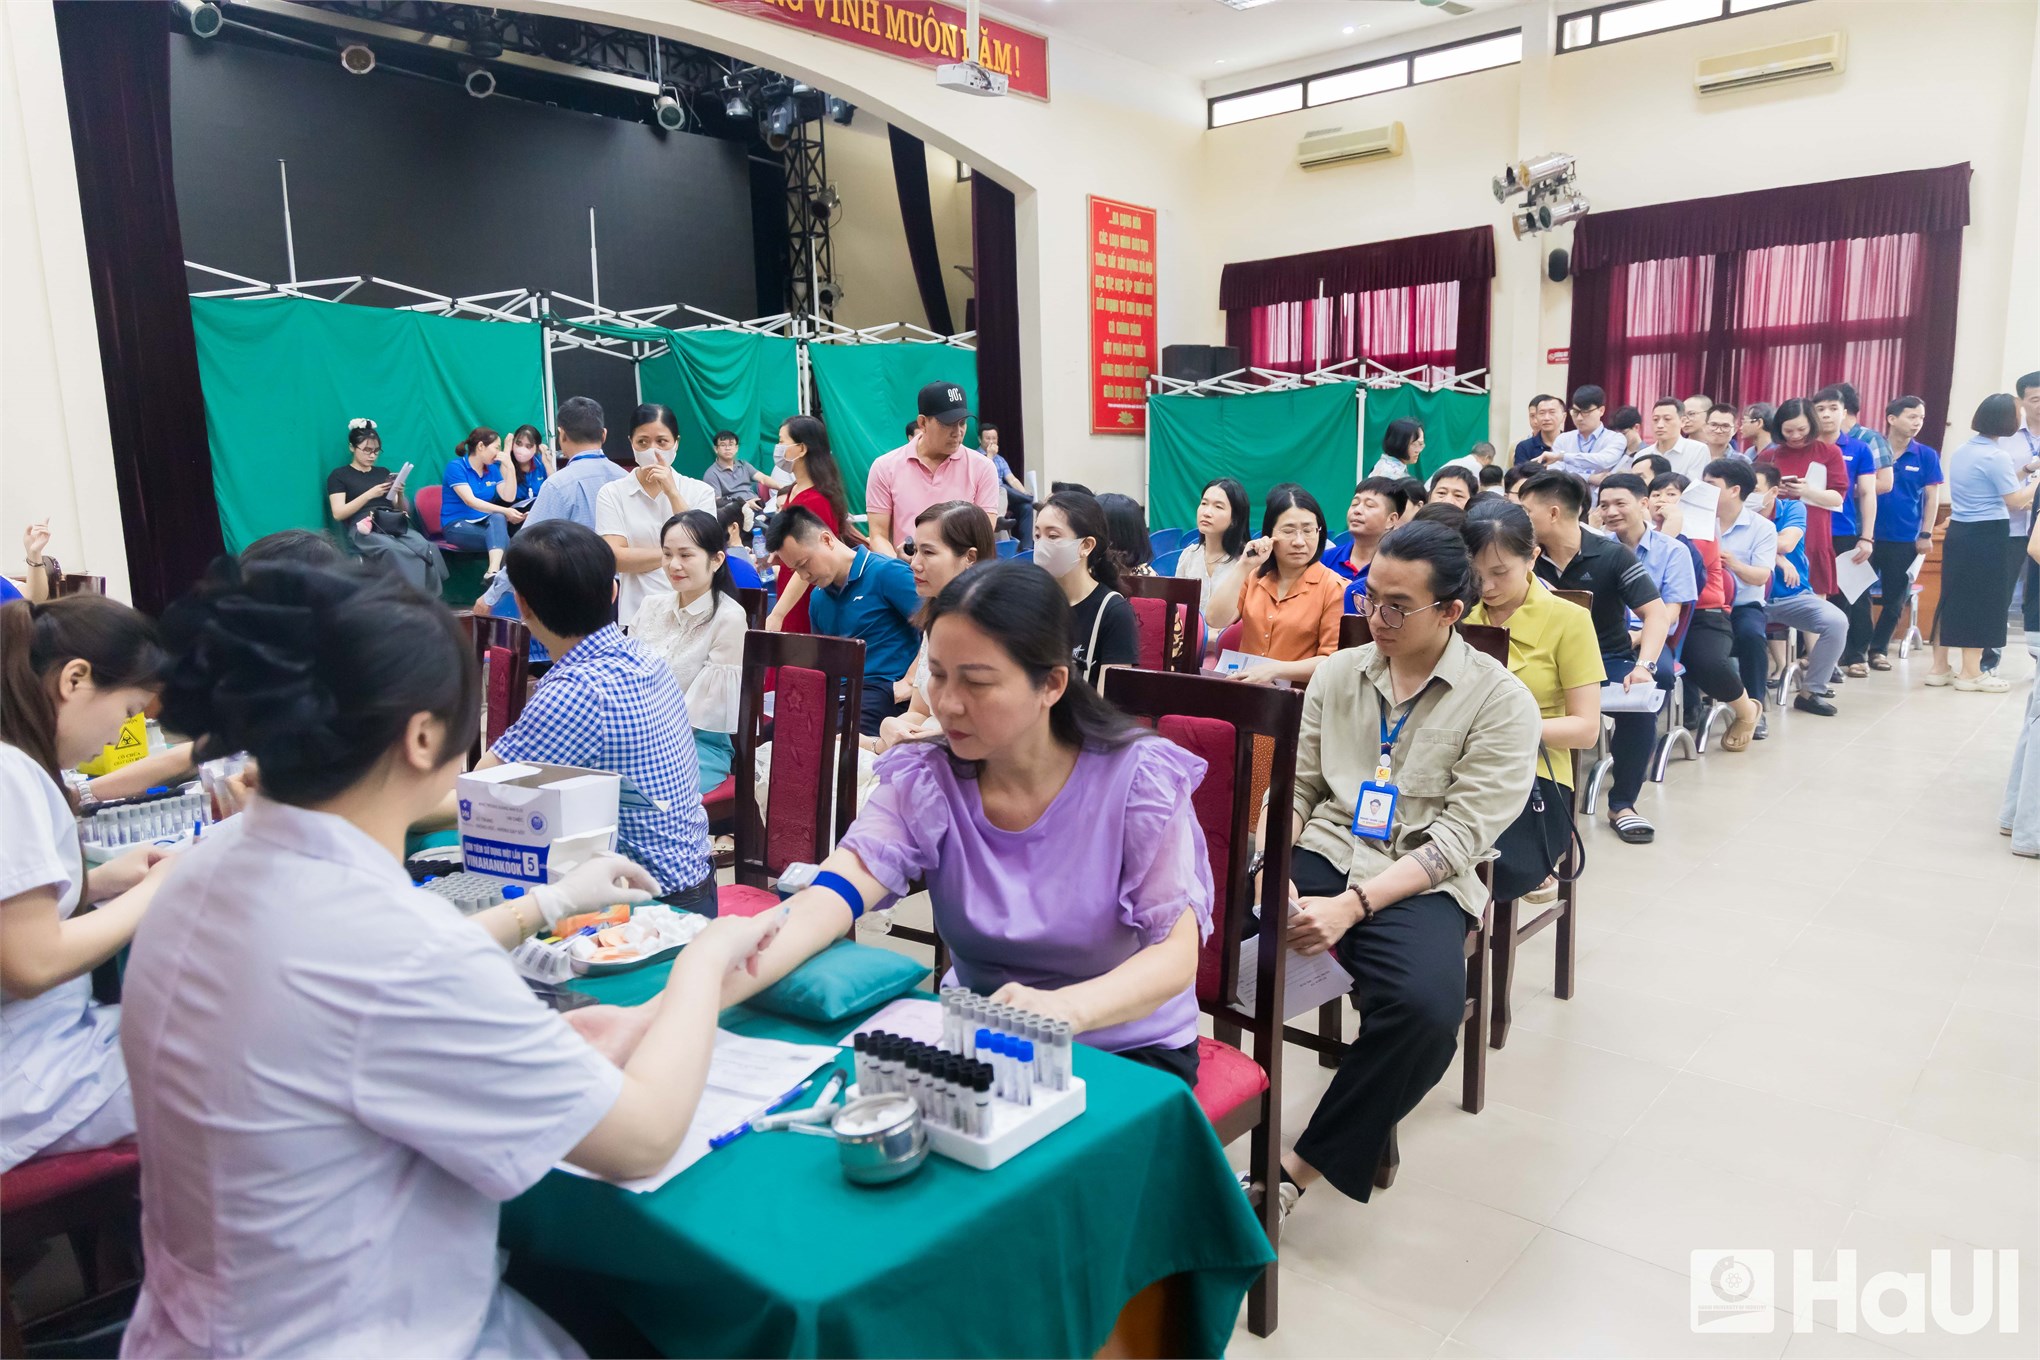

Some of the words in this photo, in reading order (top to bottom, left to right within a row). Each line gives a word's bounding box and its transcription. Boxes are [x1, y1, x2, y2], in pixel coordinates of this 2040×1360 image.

[884, 4, 958, 58] MUÔN
[465, 853, 523, 876] VINAHANKOOK
[527, 856, 535, 872] 5
